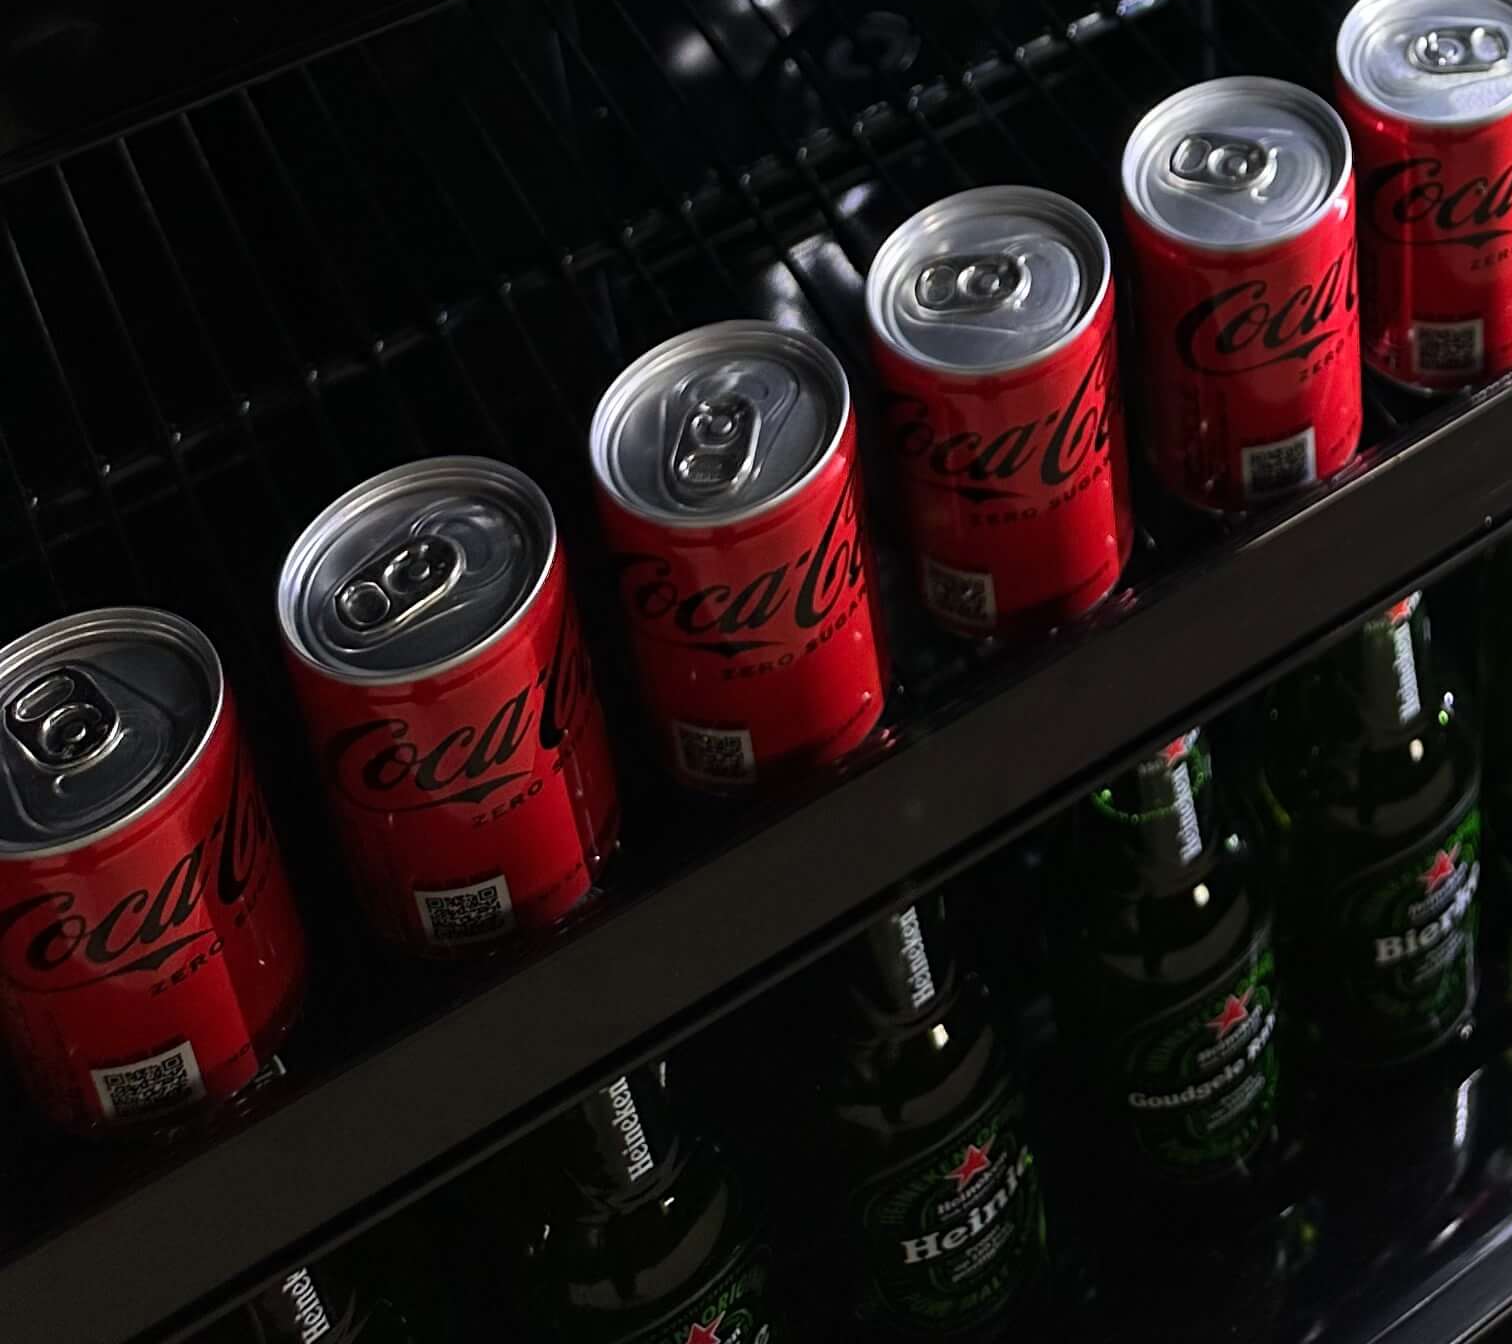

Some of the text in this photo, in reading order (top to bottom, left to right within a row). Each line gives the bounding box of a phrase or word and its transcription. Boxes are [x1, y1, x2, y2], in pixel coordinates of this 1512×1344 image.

[723, 653, 795, 681] ZERO
[472, 778, 544, 828] ZERO
[151, 936, 225, 998] ZERO
[608, 1074, 656, 1184] Heineken
[281, 1265, 332, 1344] Heinek
